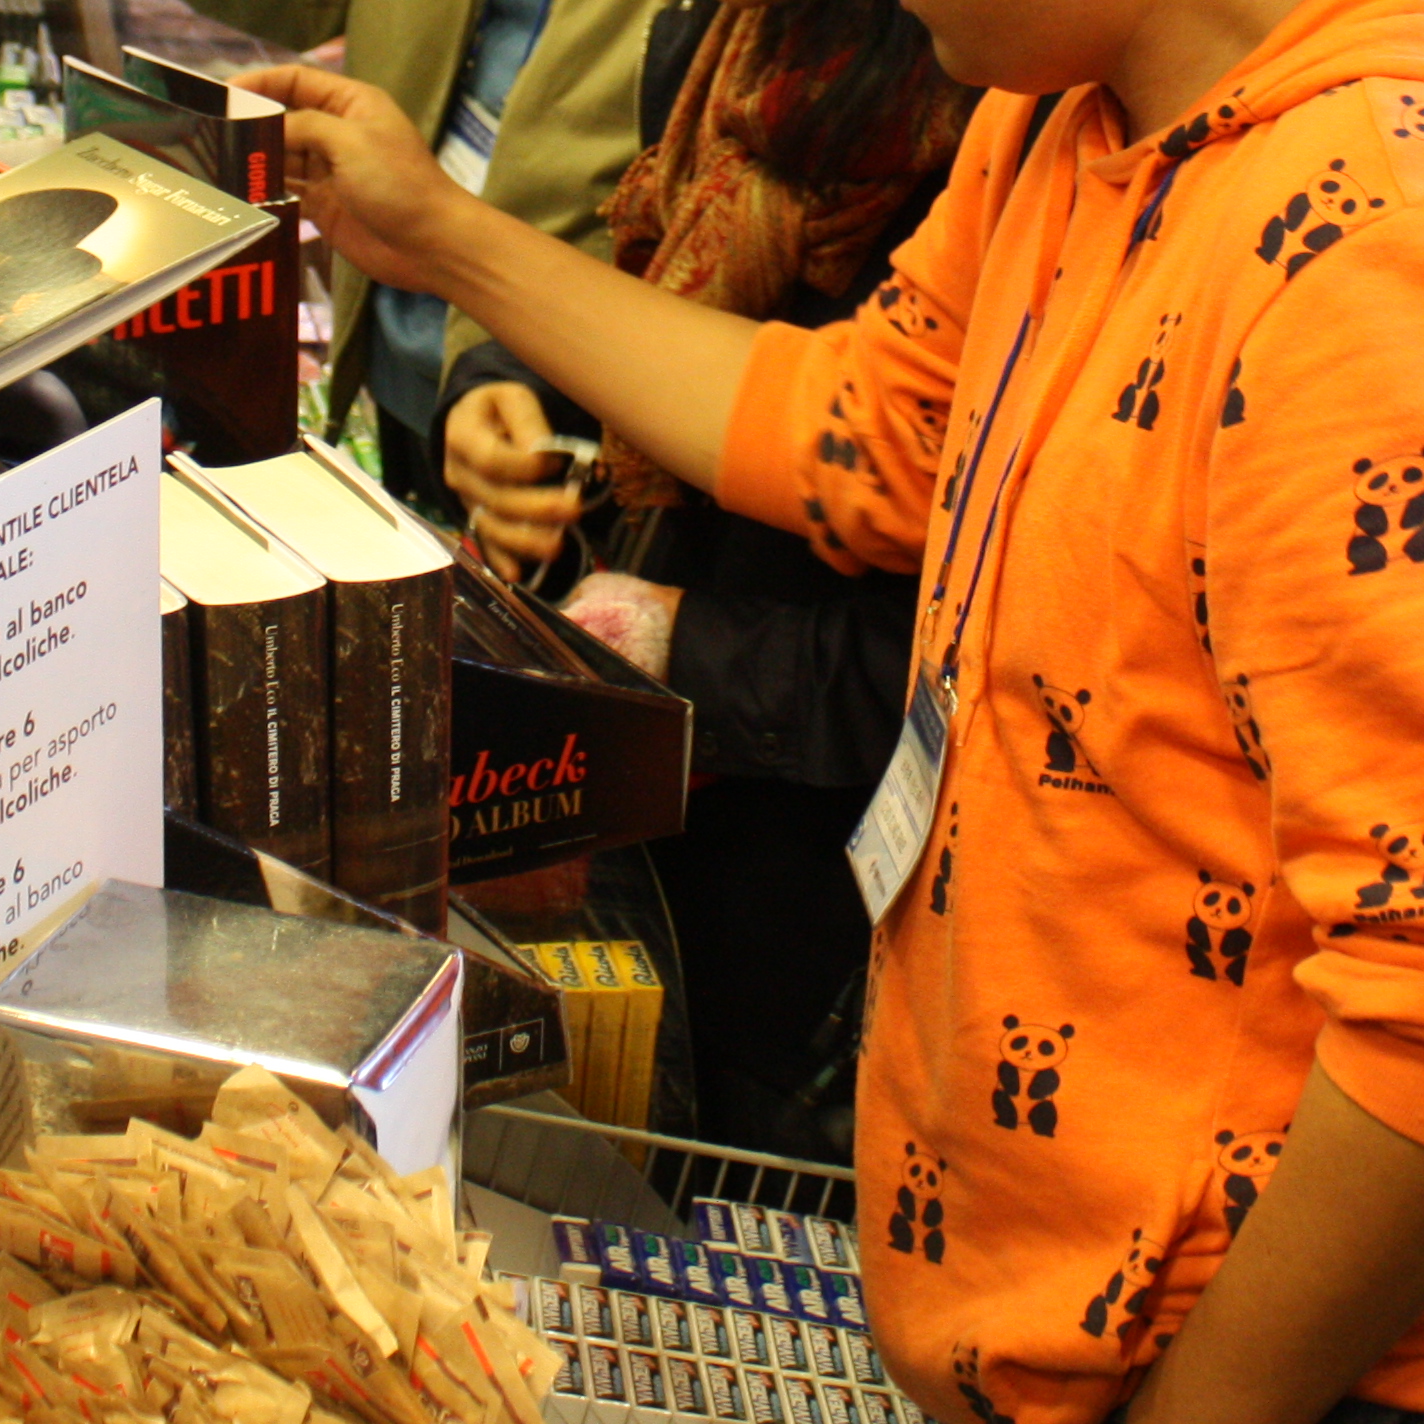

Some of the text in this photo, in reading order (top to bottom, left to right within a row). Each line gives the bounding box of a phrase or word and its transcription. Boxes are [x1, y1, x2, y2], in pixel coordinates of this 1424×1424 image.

[247, 151, 268, 204] GIORG
[87, 260, 275, 345] LETTI
[48, 454, 140, 520] CLIENTELA
[6, 607, 23, 640] al
[30, 579, 88, 628] banco
[23, 710, 35, 737] 6
[264, 624, 281, 829] Umberto Eco IL CIMITERO DI PRAGA
[390, 603, 405, 803] Umberto Eco IL CIMITERO DI PRAGA
[9, 748, 42, 792] per
[47, 702, 118, 758] asporto
[449, 733, 588, 807] abeck
[473, 788, 583, 839] ALBUM
[5, 892, 22, 925] al
[27, 860, 84, 912] banco
[13, 857, 26, 884] 6
[607, 1245, 635, 1273] AIR
[647, 1256, 674, 1284] AIR
[686, 1266, 716, 1294] AIR
[725, 1276, 753, 1305] AIR
[762, 1283, 793, 1313] AIR
[799, 1289, 828, 1318] AIR
[837, 1296, 865, 1325] AIR
